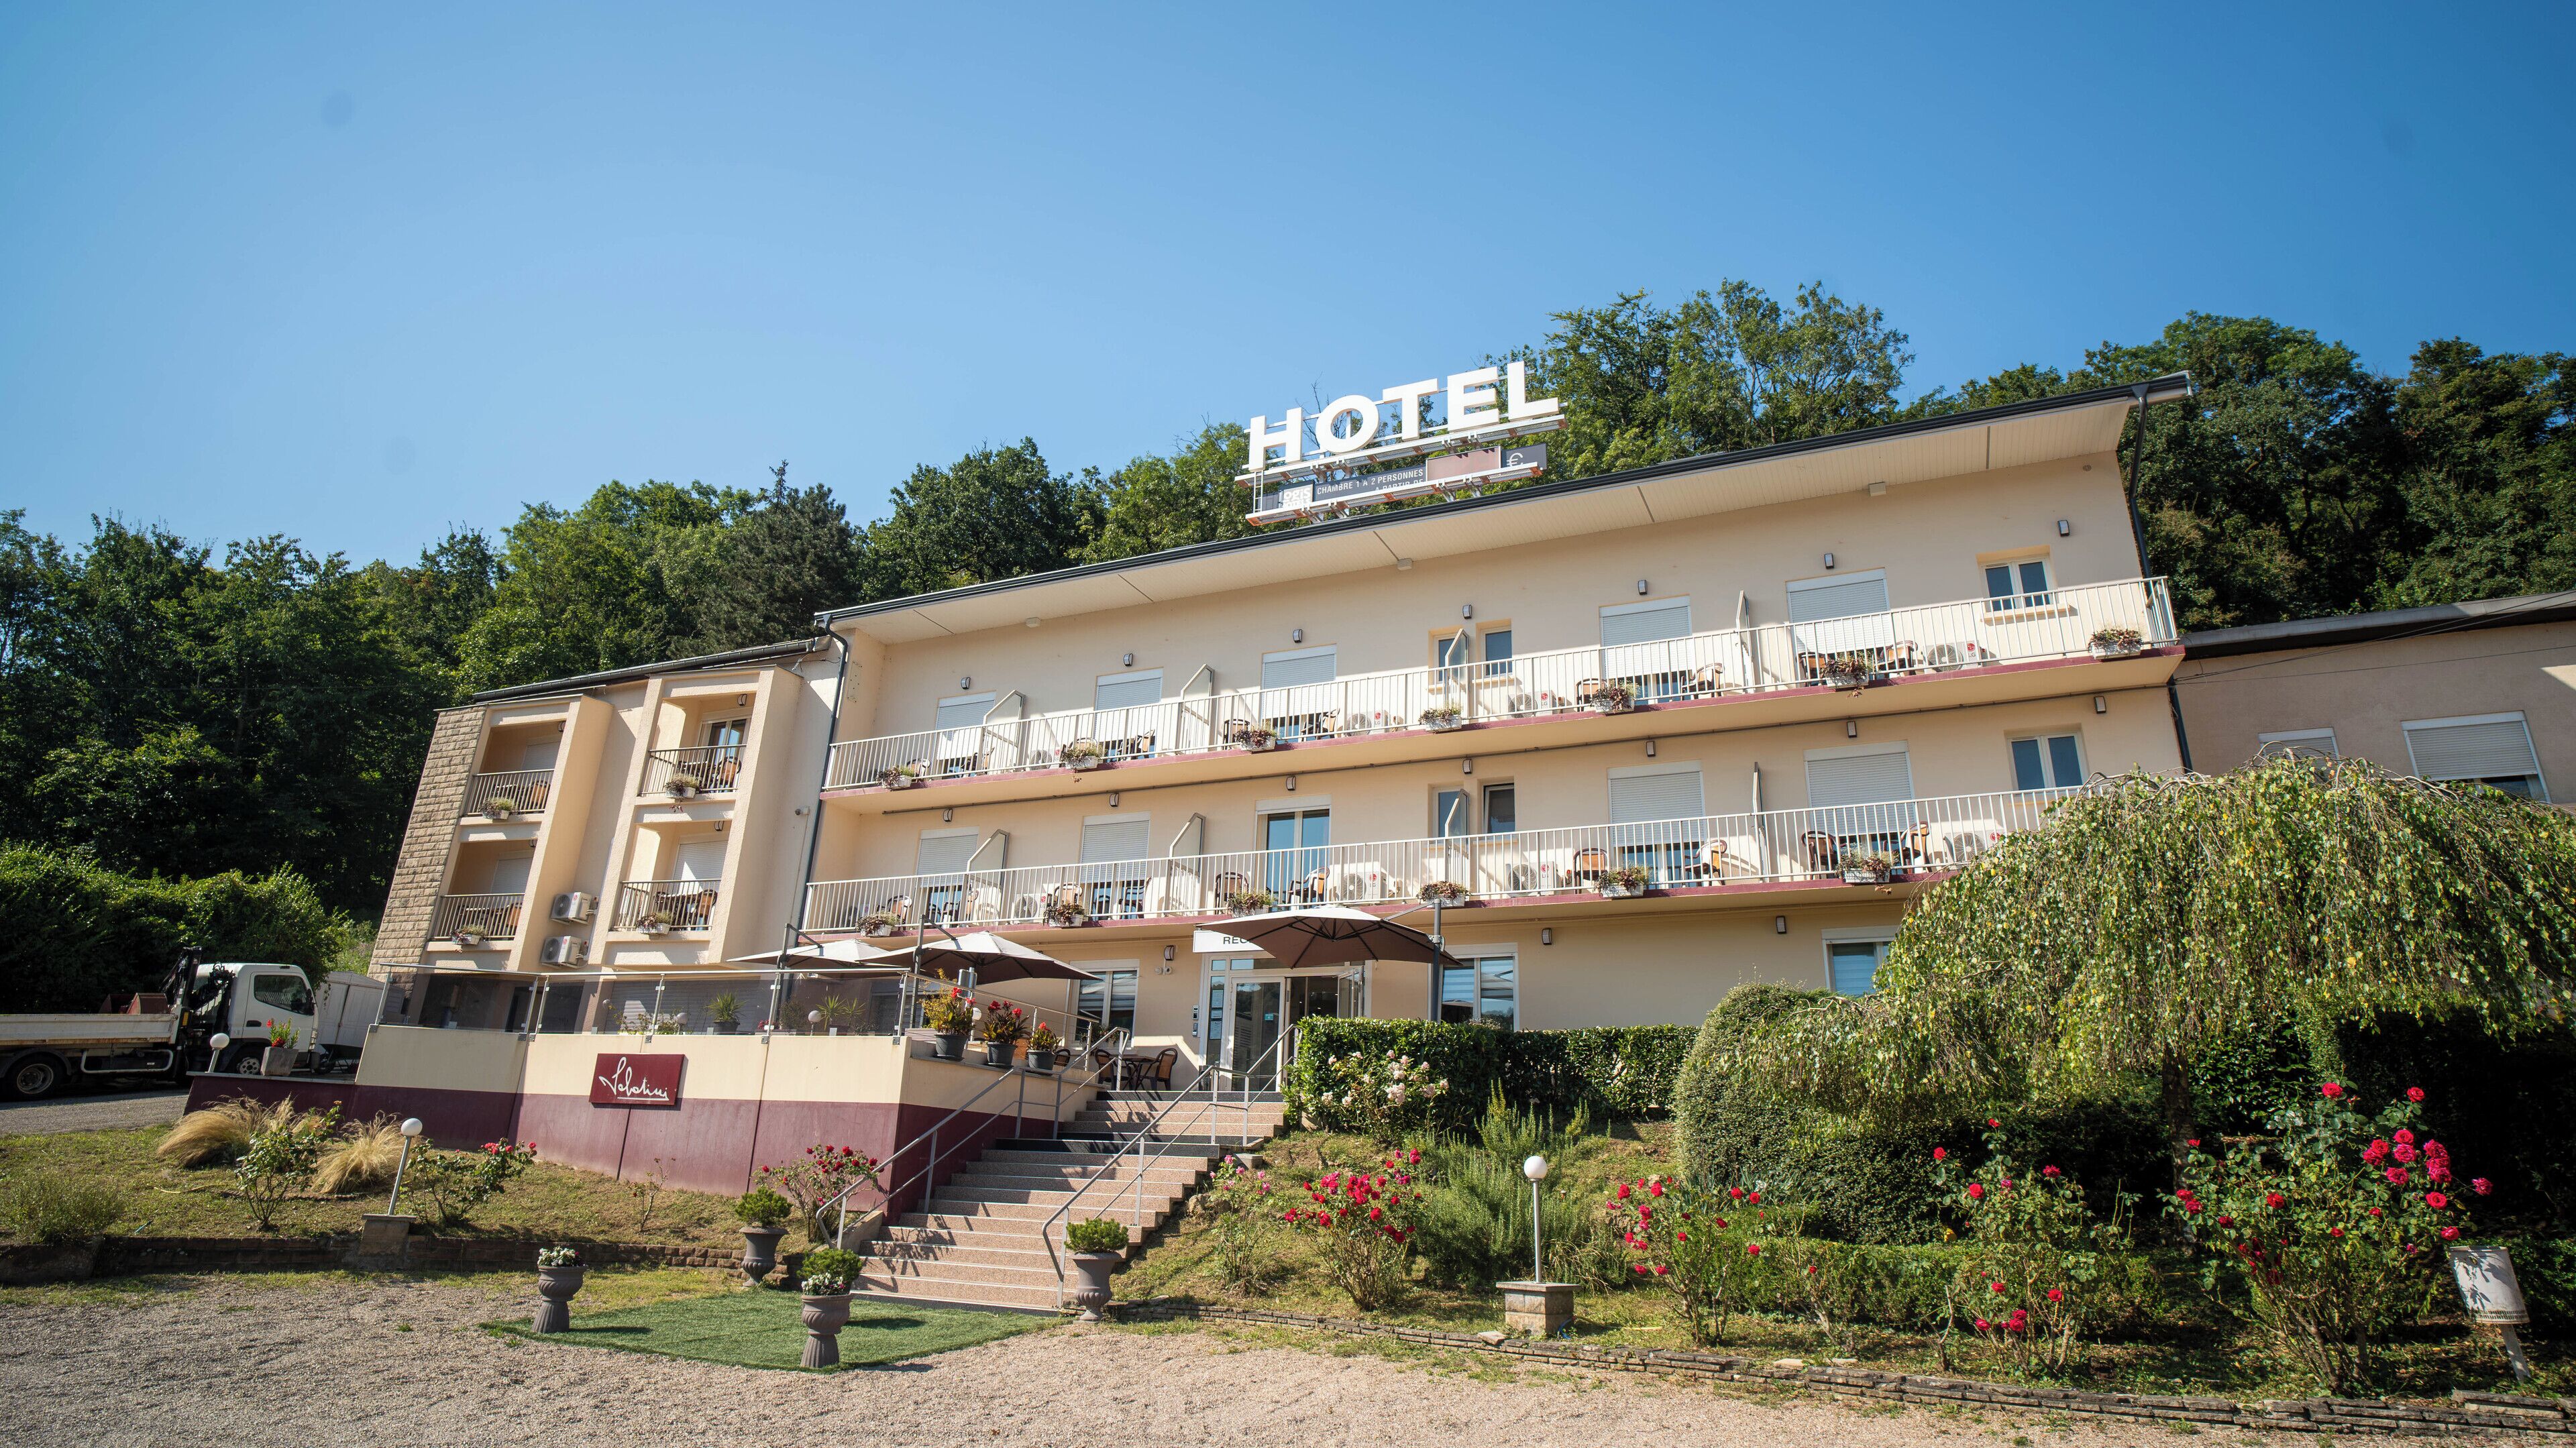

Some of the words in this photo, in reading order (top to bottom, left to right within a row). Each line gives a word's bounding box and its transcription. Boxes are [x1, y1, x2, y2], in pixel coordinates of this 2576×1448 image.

[1248, 361, 1559, 471] HOTEL
[1317, 482, 1353, 495] CHAMBRE
[1378, 469, 1424, 484] PERSONNES
[1283, 487, 1309, 502] ogis
[1223, 936, 1250, 944] REC
